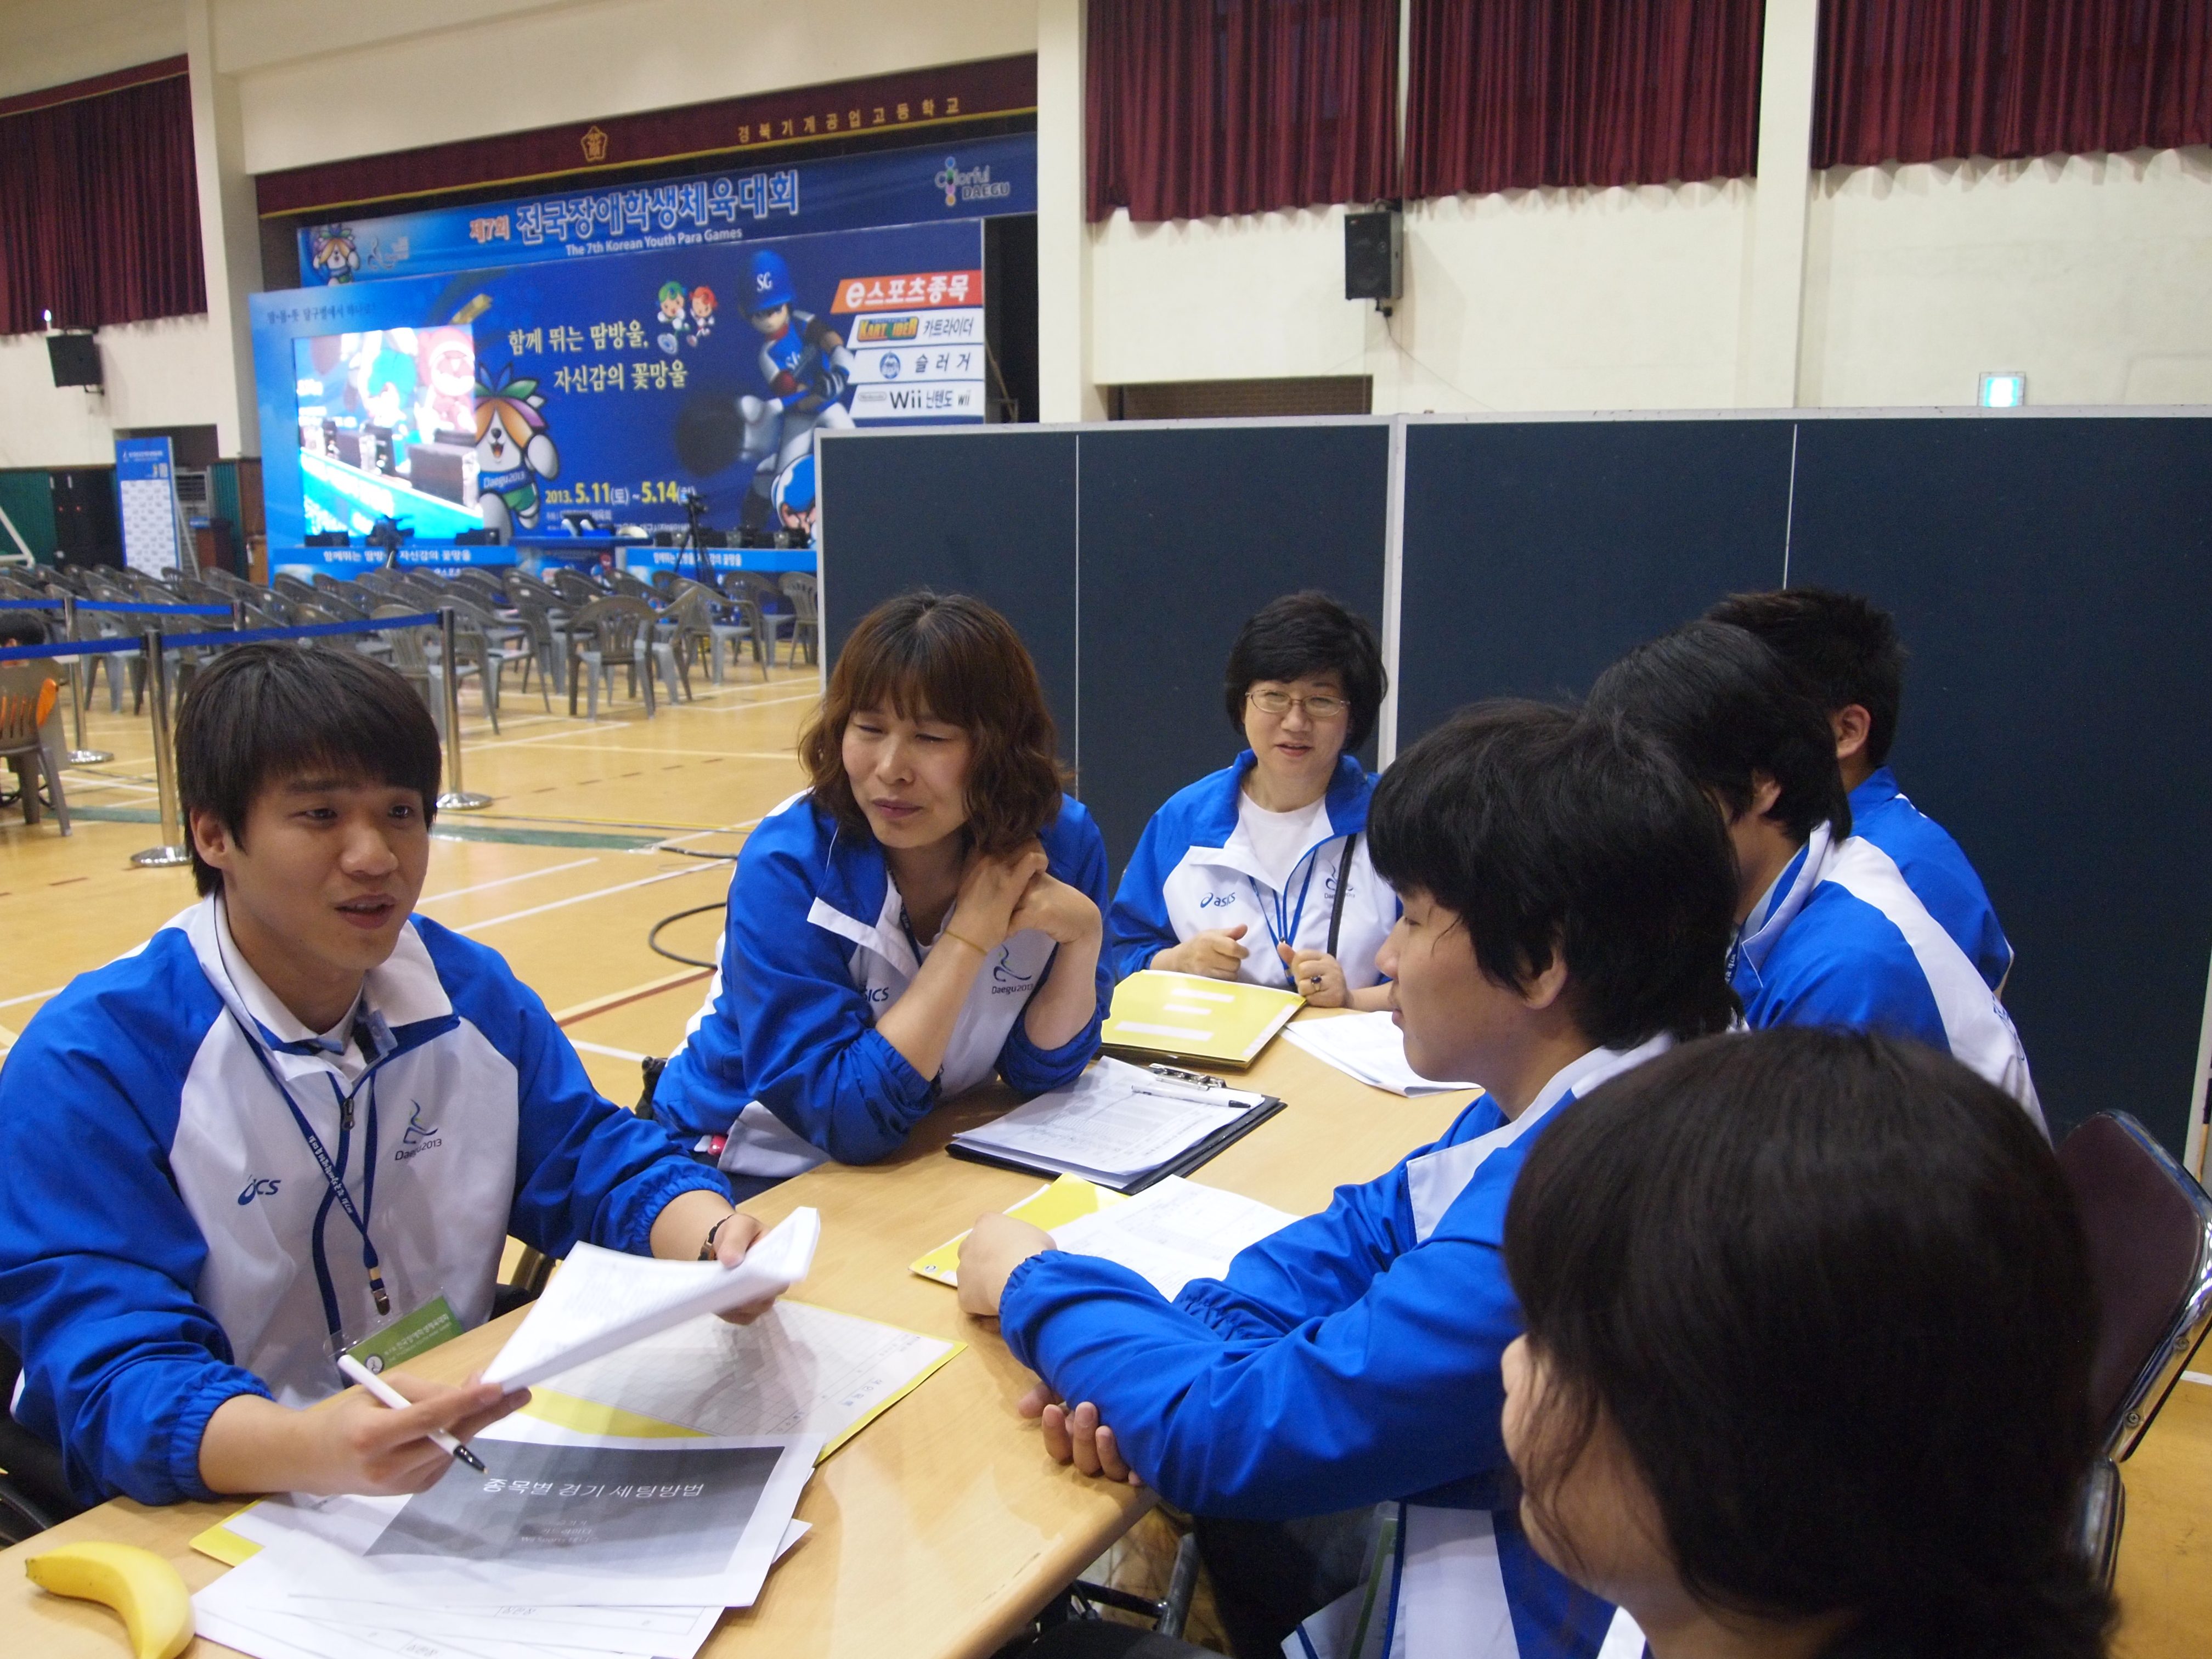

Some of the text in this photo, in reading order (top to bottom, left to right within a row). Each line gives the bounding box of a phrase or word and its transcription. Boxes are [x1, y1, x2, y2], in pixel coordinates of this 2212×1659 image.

[470, 170, 798, 245] 제7회 전국장애학생체육대회
[566, 228, 743, 256] The 7th Korean Youth Para Games
[846, 274, 968, 308] e스포츠종목
[509, 319, 649, 356] 함께 뛰는 땀방울,
[923, 317, 974, 337] 카트라이더
[554, 359, 687, 393] 자신감의 꽃망울
[889, 390, 921, 409] Wii
[926, 390, 953, 409] 닌텐도
[545, 490, 572, 504] 2013.
[483, 1479, 704, 1498] 종목별 경기 세팅방법
